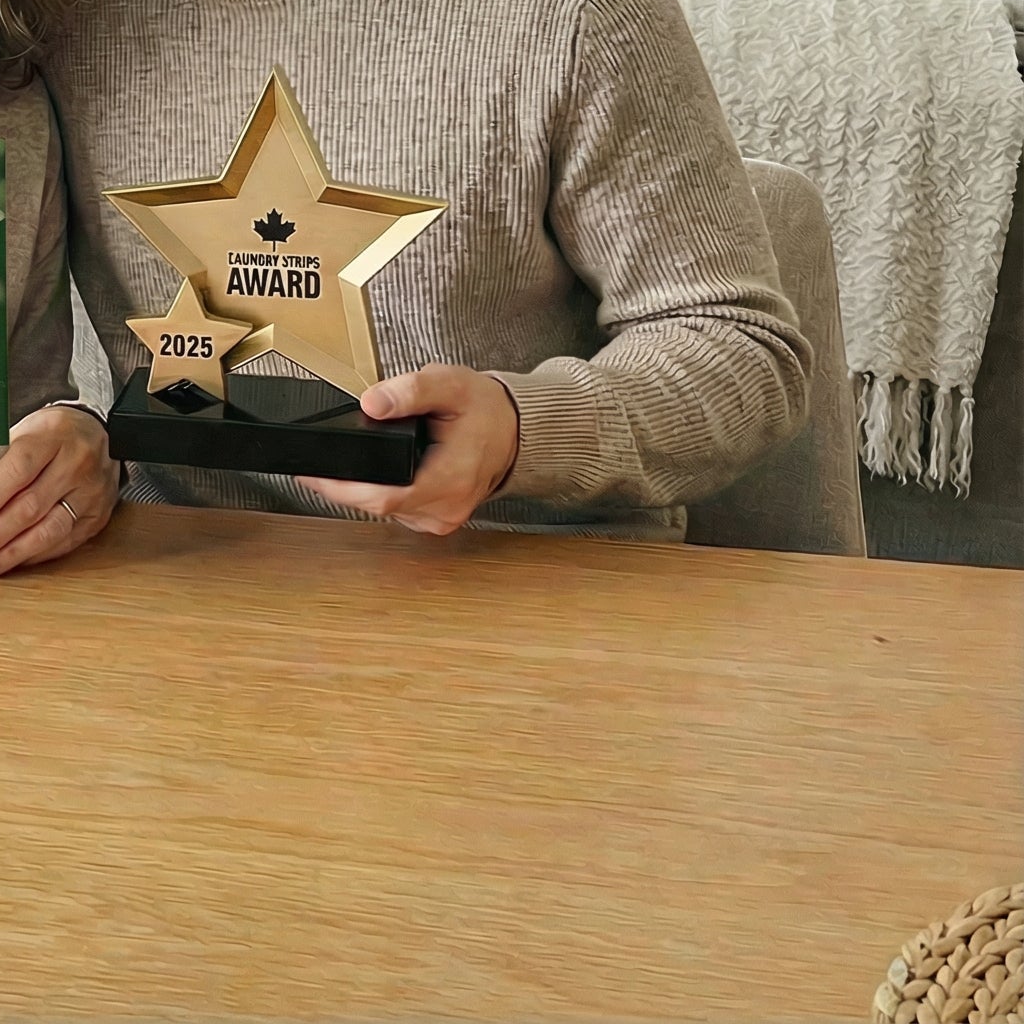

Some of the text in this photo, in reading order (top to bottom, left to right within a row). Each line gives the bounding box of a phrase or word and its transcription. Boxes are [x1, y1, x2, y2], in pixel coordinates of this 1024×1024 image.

[282, 255, 321, 270] STRIPS
[226, 267, 321, 299] AWARD
[160, 333, 214, 358] 2025
